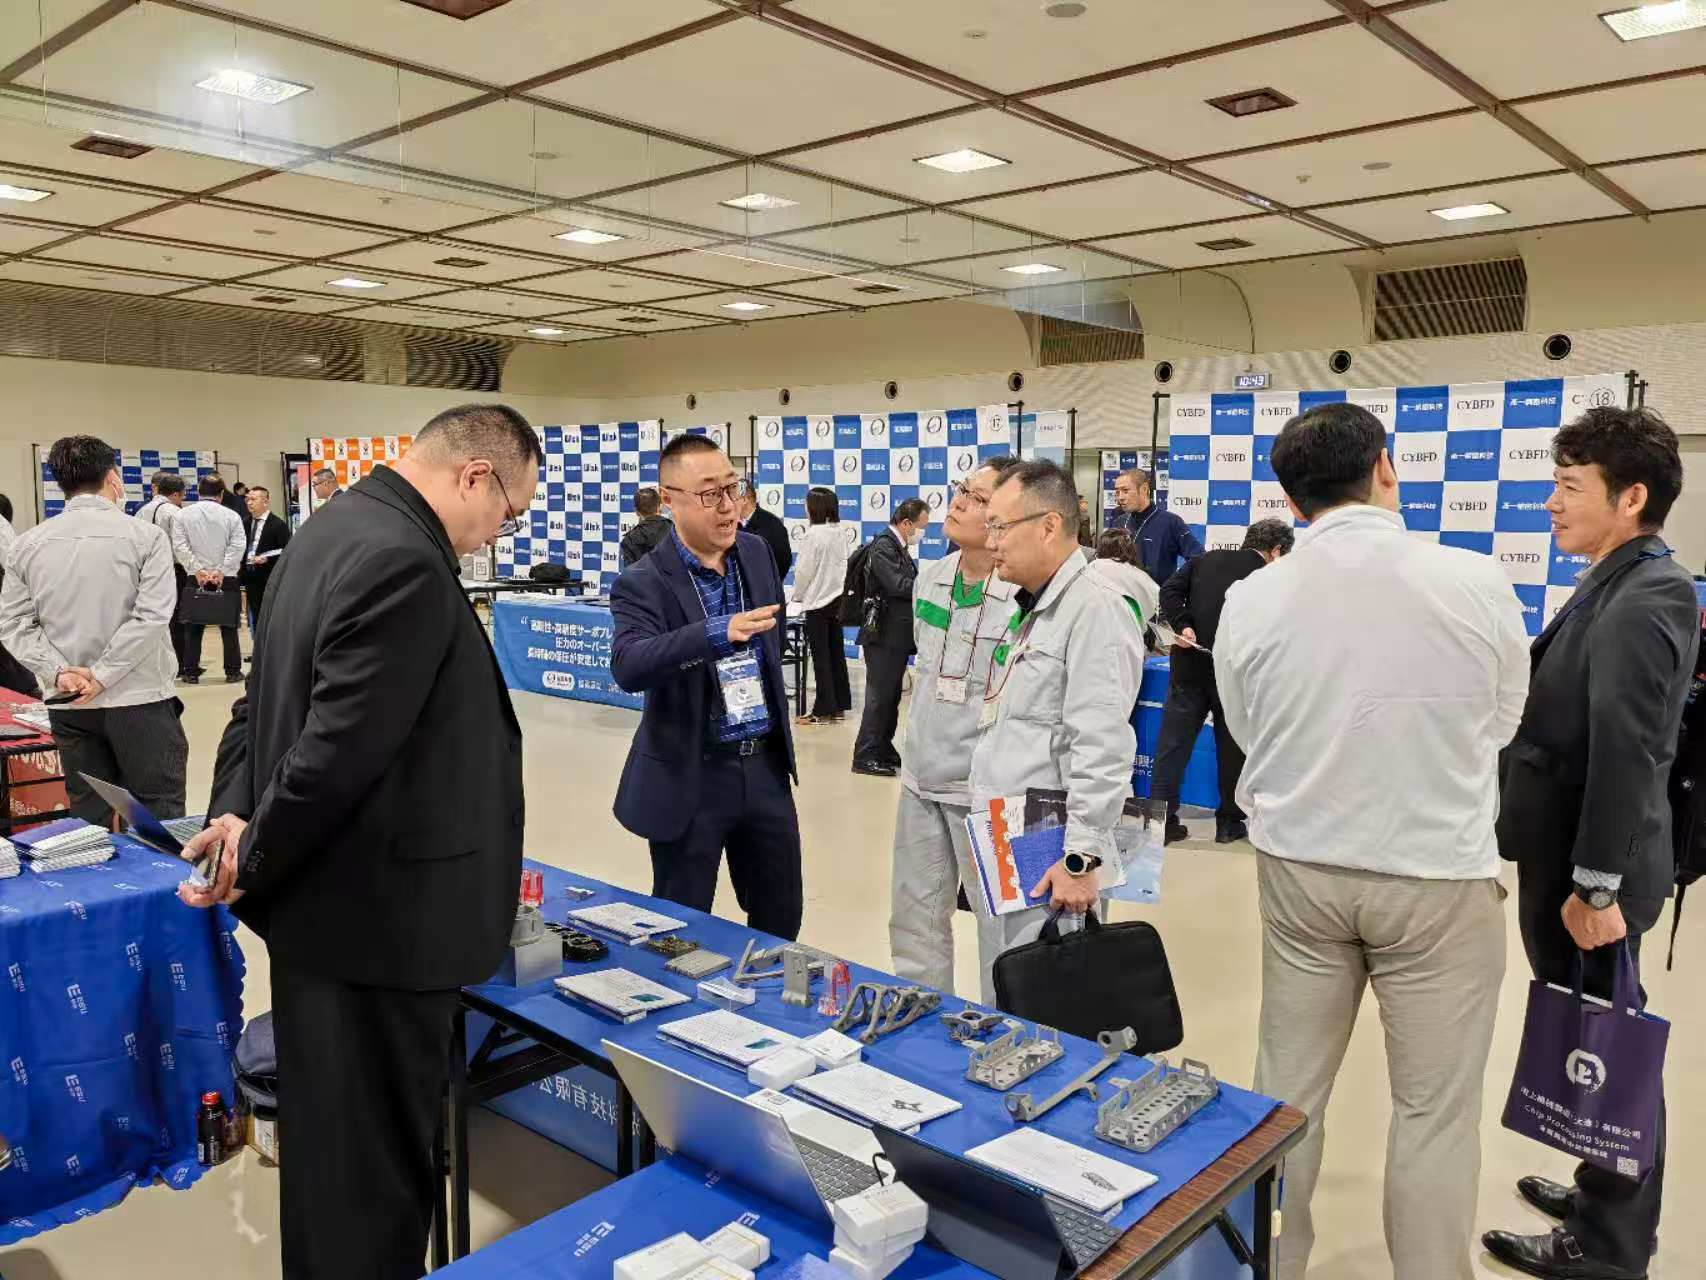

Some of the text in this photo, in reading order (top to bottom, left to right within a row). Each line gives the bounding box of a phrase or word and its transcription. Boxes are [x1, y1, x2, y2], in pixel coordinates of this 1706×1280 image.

[1456, 399, 1495, 410] CYBFD
[1176, 408, 1206, 417] CYBFD
[1261, 407, 1293, 416] CYBFD
[1215, 453, 1246, 462] CYBFD
[1401, 452, 1437, 462] CYBFD
[1173, 497, 1202, 506] CYBFD
[1449, 502, 1487, 511] CYBFD
[1500, 553, 1540, 563] CYBFD
[1594, 1135, 1630, 1153] System
